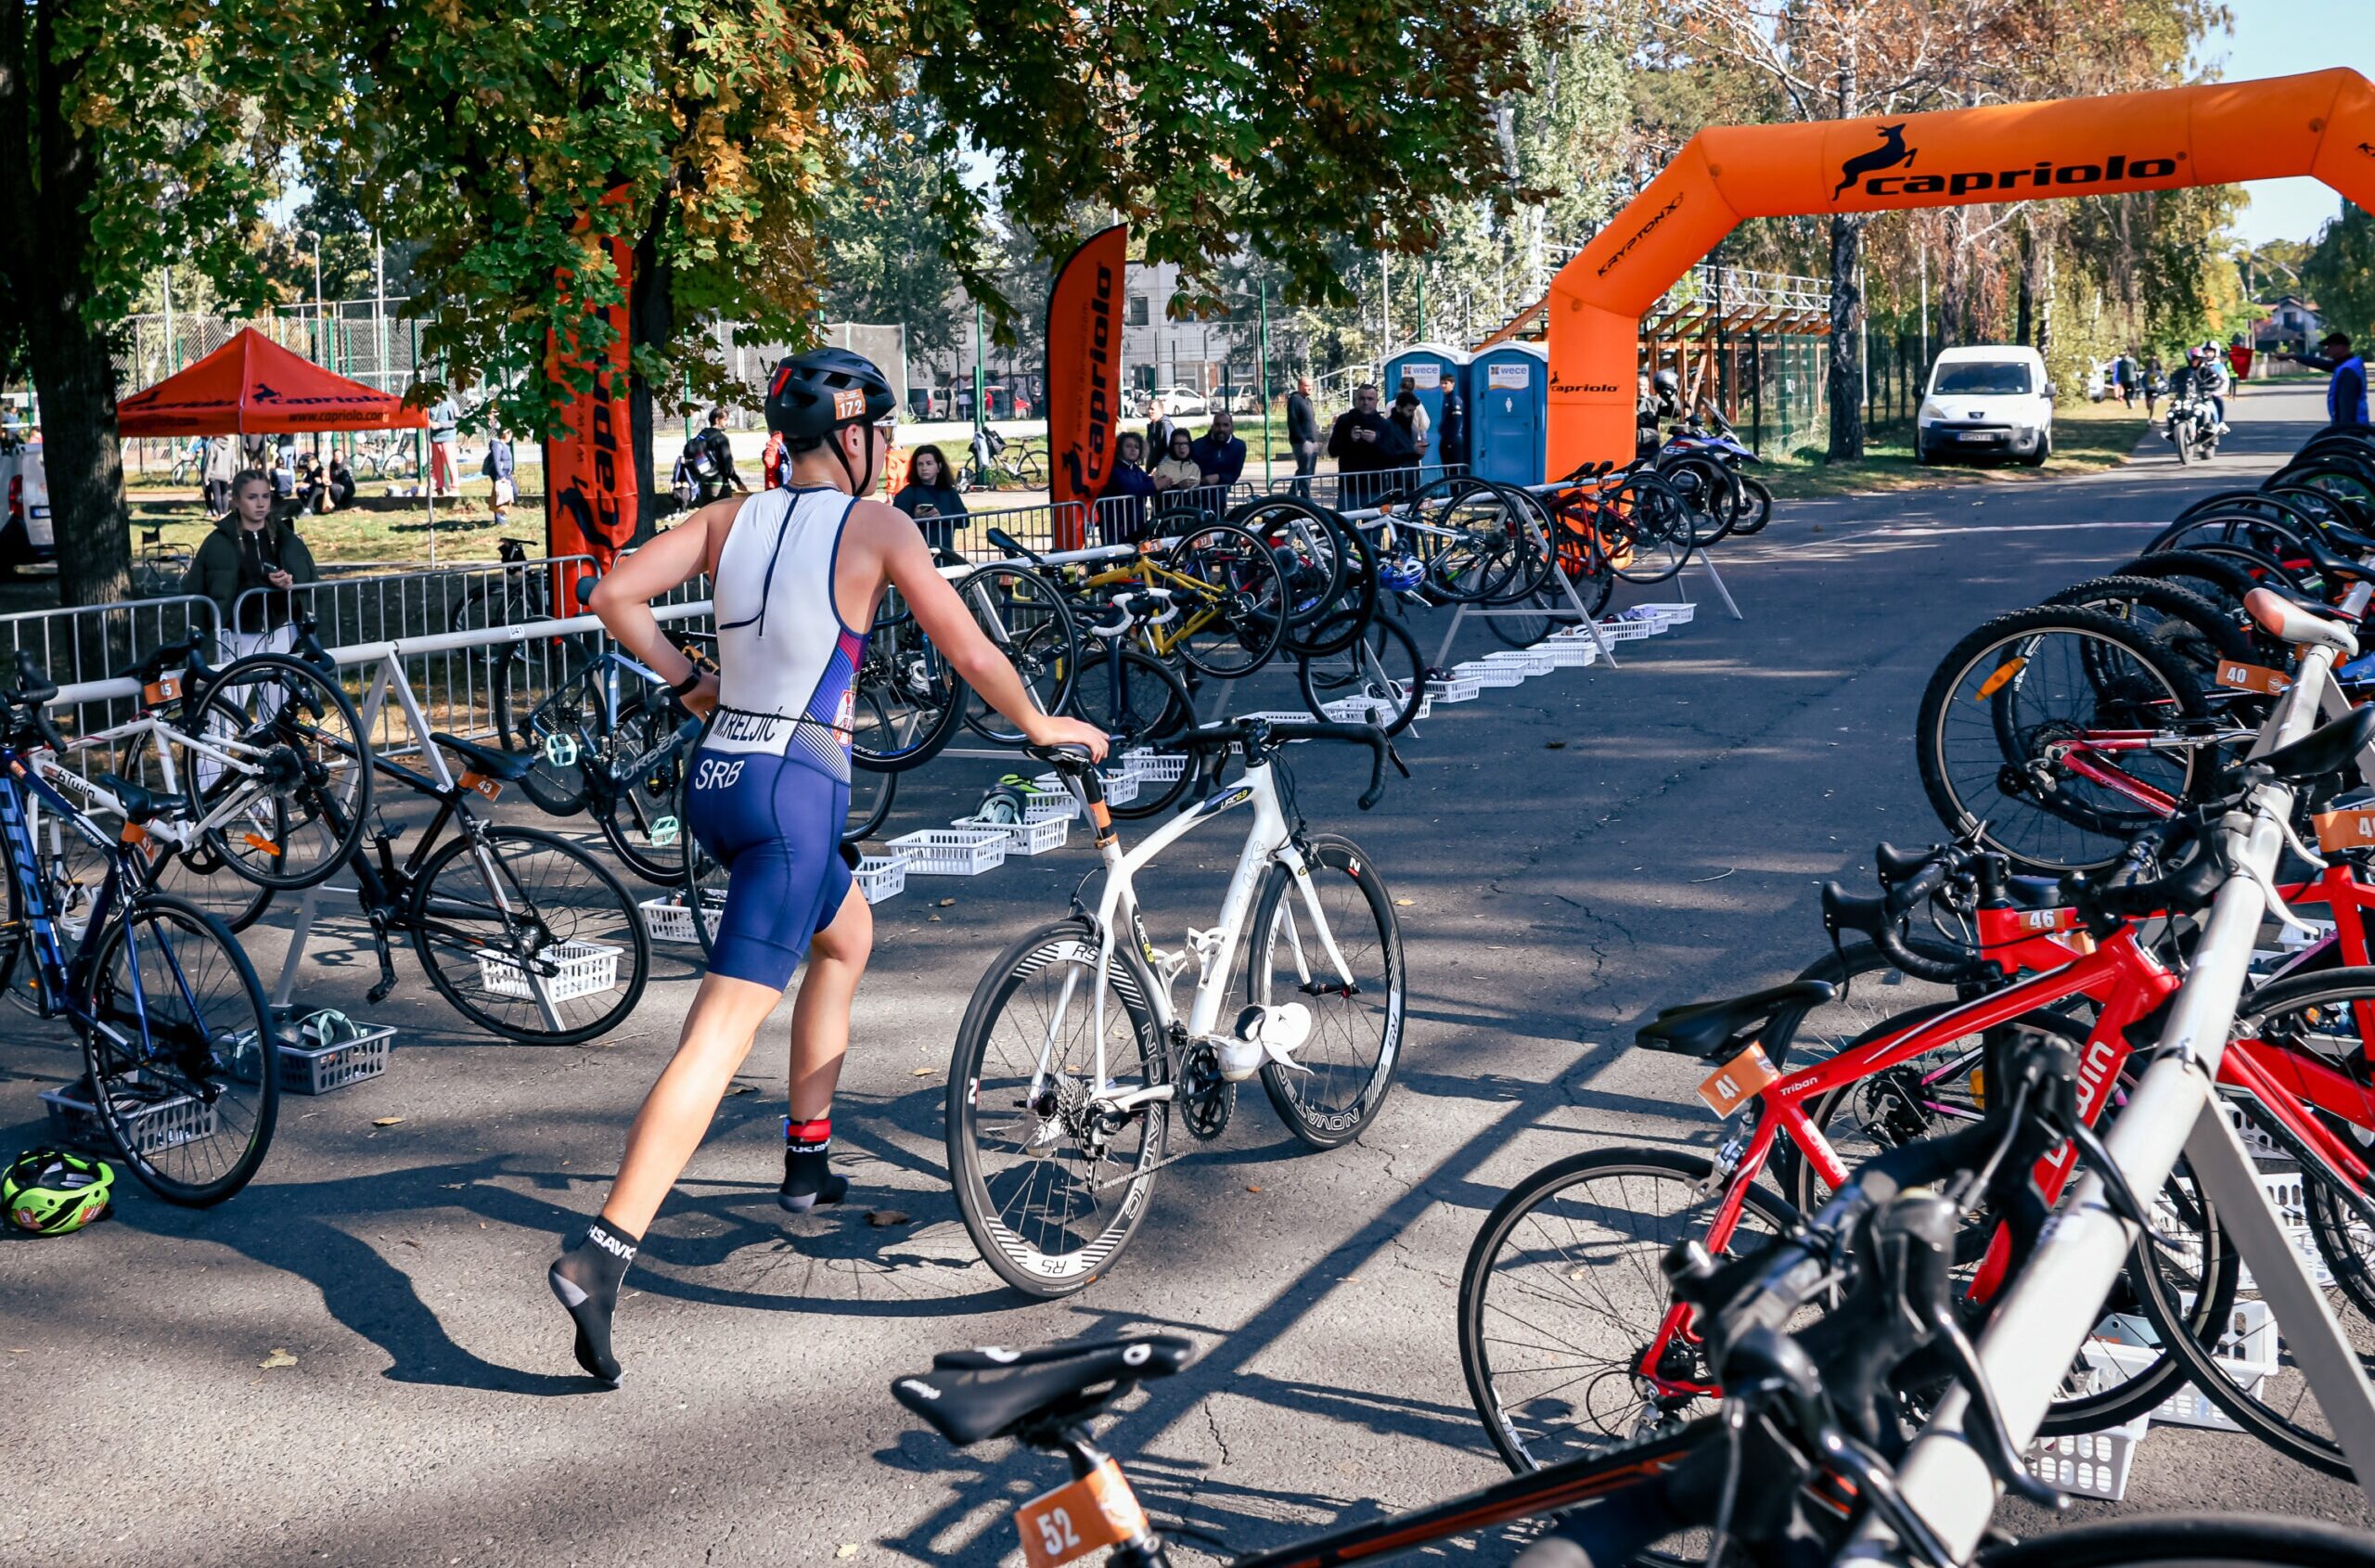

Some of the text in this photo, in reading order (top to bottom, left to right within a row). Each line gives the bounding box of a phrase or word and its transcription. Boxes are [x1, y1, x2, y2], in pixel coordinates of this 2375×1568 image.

[1866, 155, 2176, 197] capriolo
[1087, 266, 1111, 481] capriolo
[1412, 366, 1438, 374] wece
[1500, 366, 1527, 374] wece
[1551, 383, 1618, 393] capriolo
[268, 393, 392, 405] capriolo
[289, 410, 391, 423] www.capriolo.com
[839, 399, 863, 419] 172
[1663, 445, 1688, 454] GS
[2227, 666, 2247, 684] 40
[621, 731, 685, 781] ORBEA
[696, 758, 746, 790] SRB
[477, 779, 493, 794] 43
[2359, 816, 2375, 838] 4
[2029, 910, 2055, 929] 46
[1072, 944, 1098, 963] RS
[1779, 1076, 1818, 1096] Triban
[1036, 1507, 1080, 1556] 52
